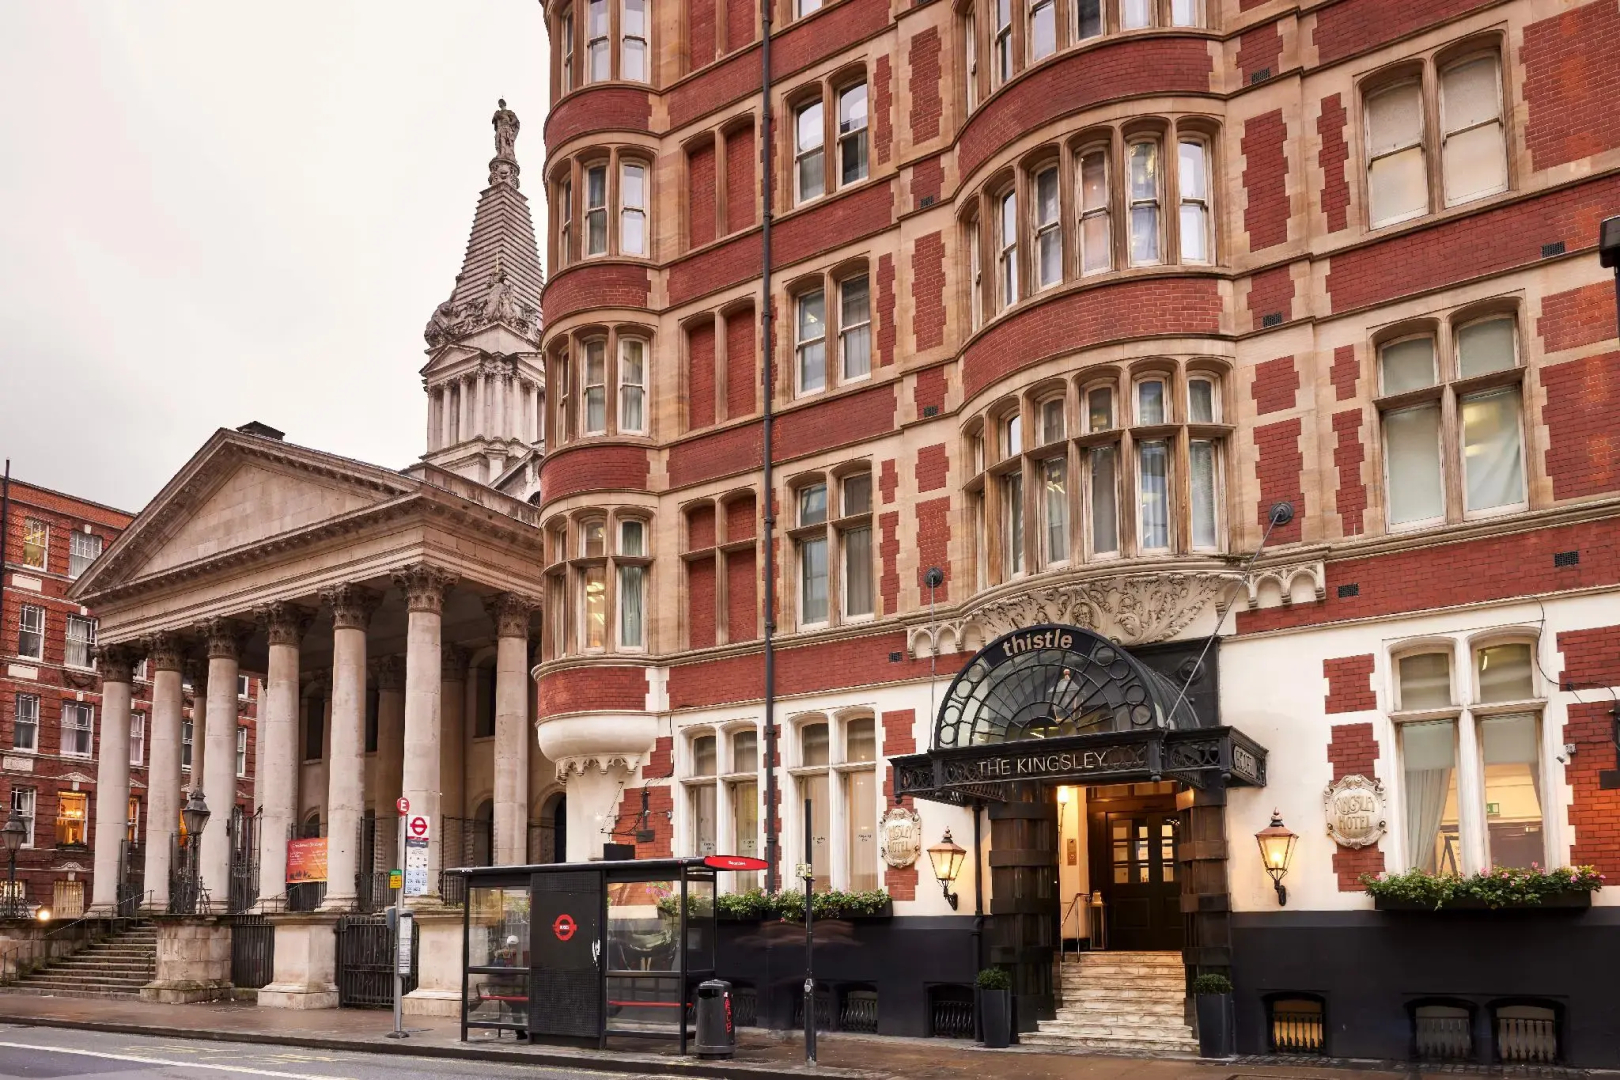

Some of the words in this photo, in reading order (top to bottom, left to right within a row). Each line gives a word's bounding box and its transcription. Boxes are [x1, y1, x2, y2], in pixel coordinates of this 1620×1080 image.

[1002, 628, 1073, 657] thistle
[977, 759, 1010, 776] THE
[1017, 751, 1106, 774] KINGSLEY
[400, 799, 407, 811] E
[1338, 816, 1369, 830] HOTEL
